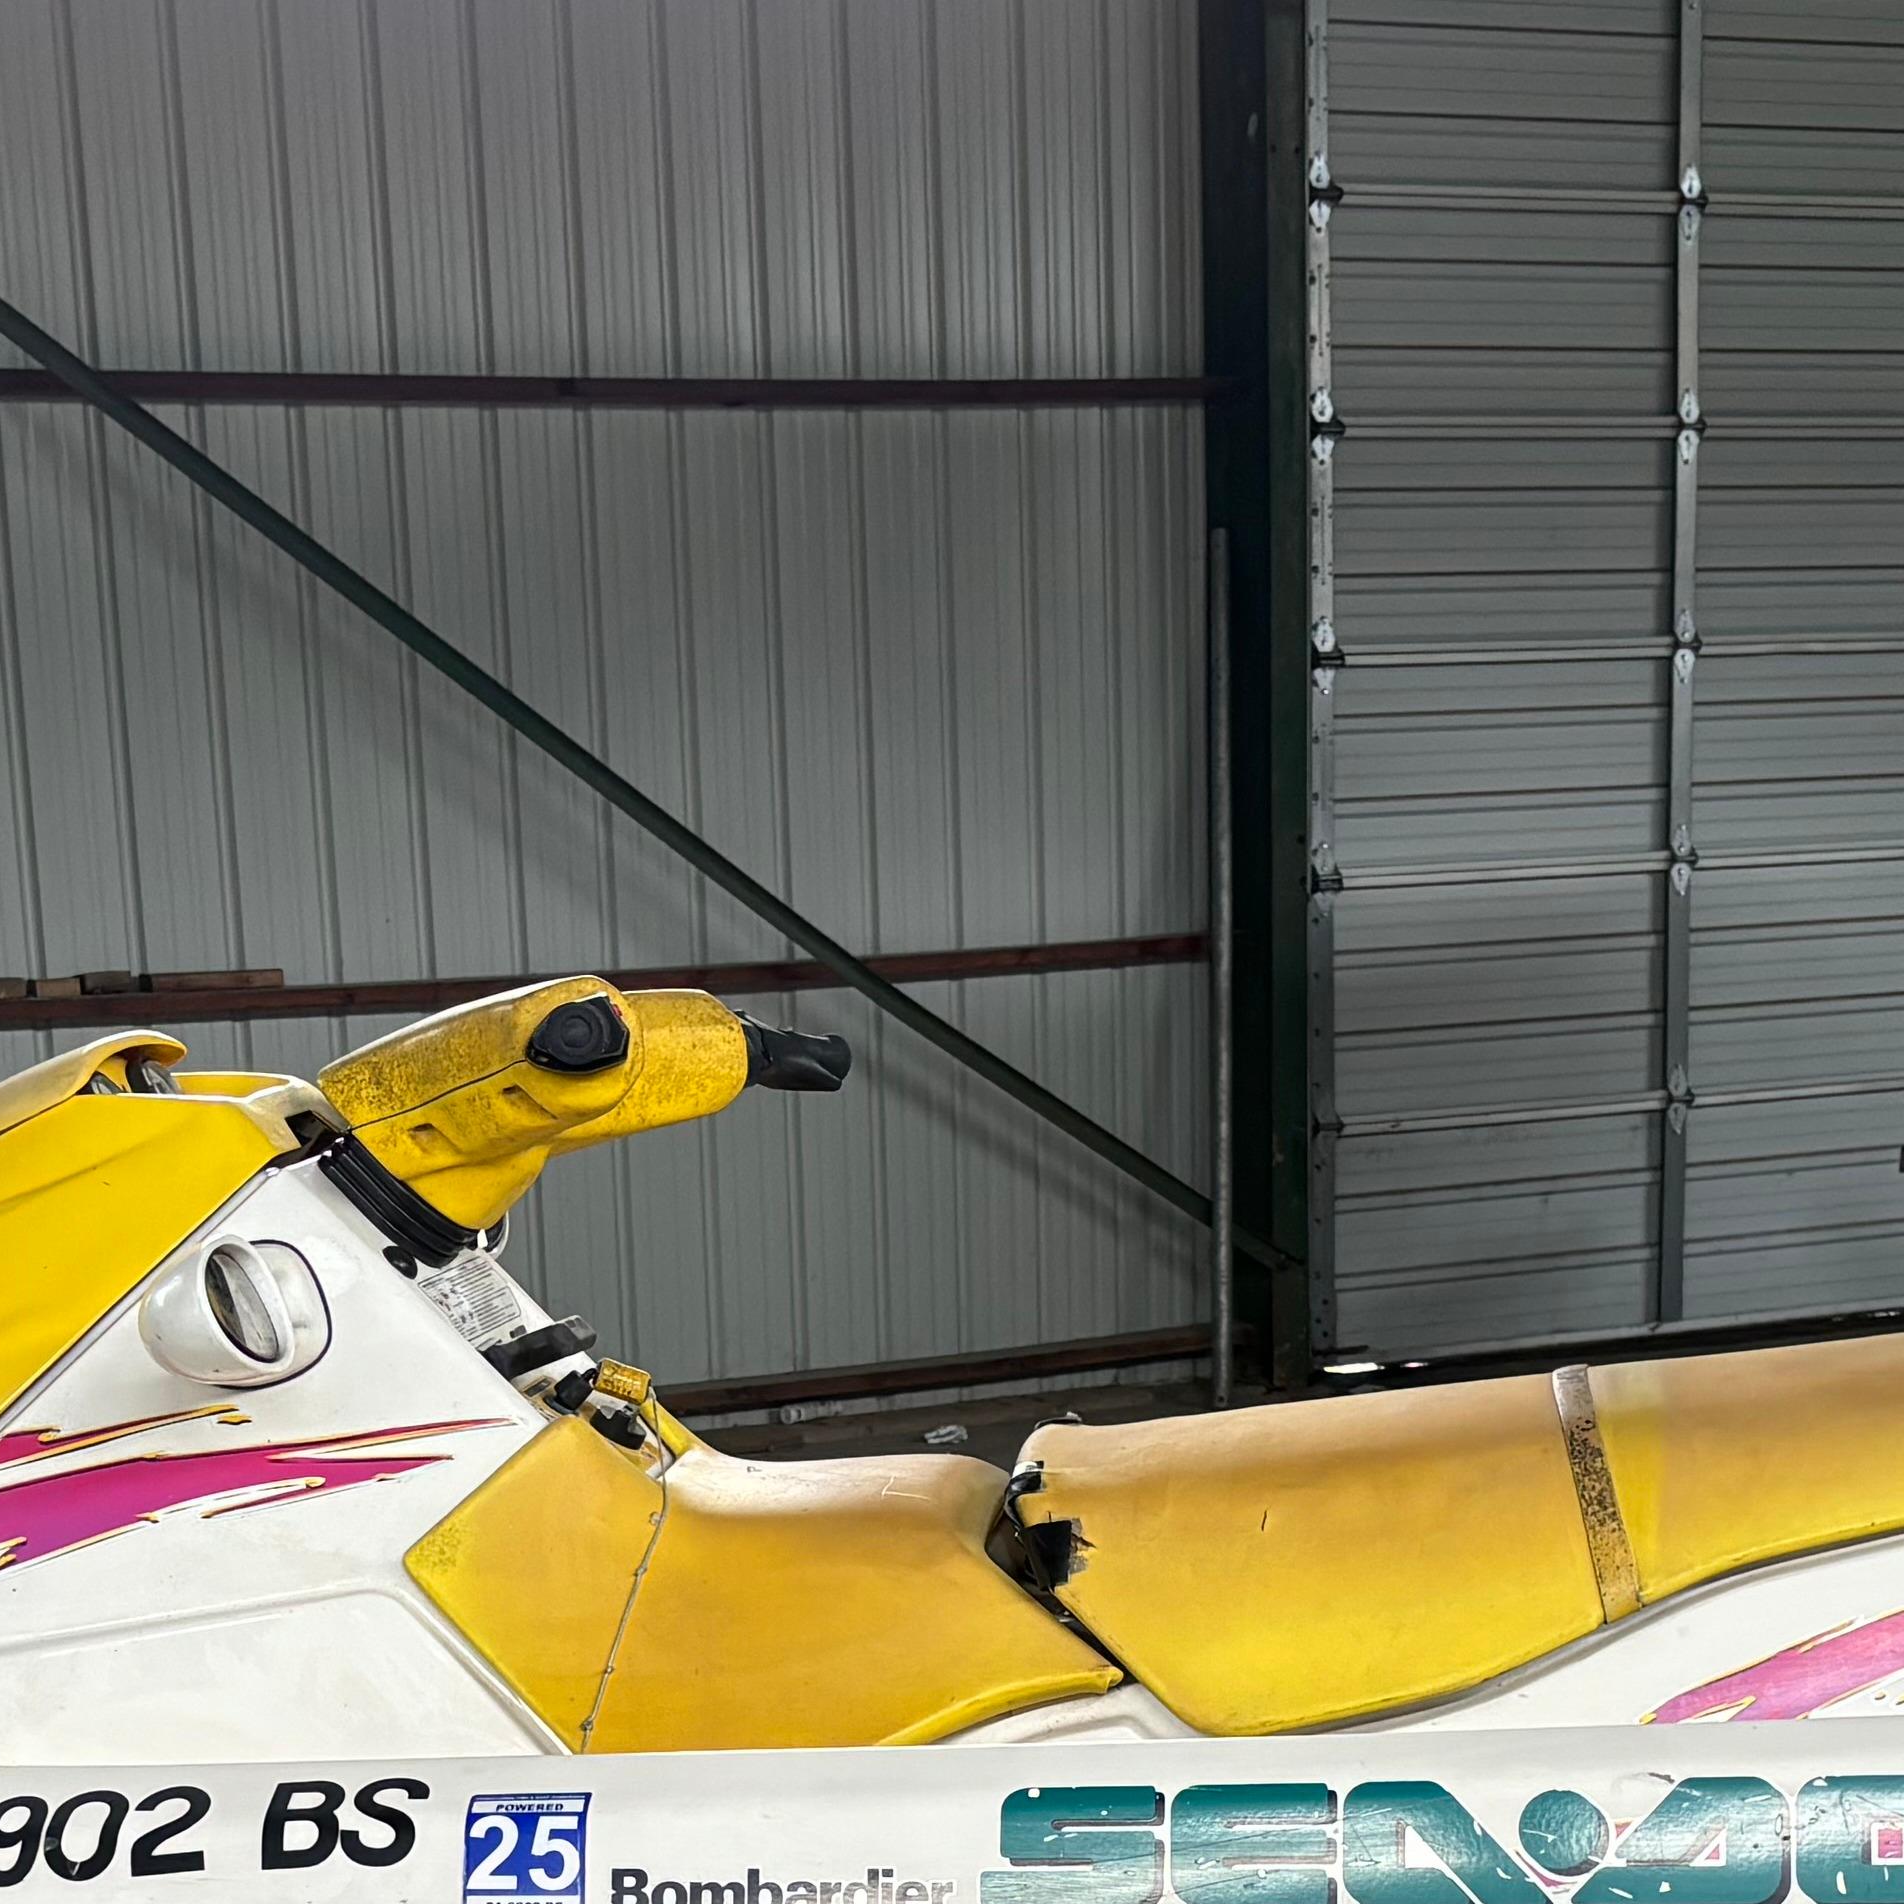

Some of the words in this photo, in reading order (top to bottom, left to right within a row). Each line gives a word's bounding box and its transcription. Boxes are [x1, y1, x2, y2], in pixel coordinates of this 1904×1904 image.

[261, 1777, 431, 1870] BS
[495, 1803, 564, 1812] POWERED
[466, 1814, 581, 1891] 25
